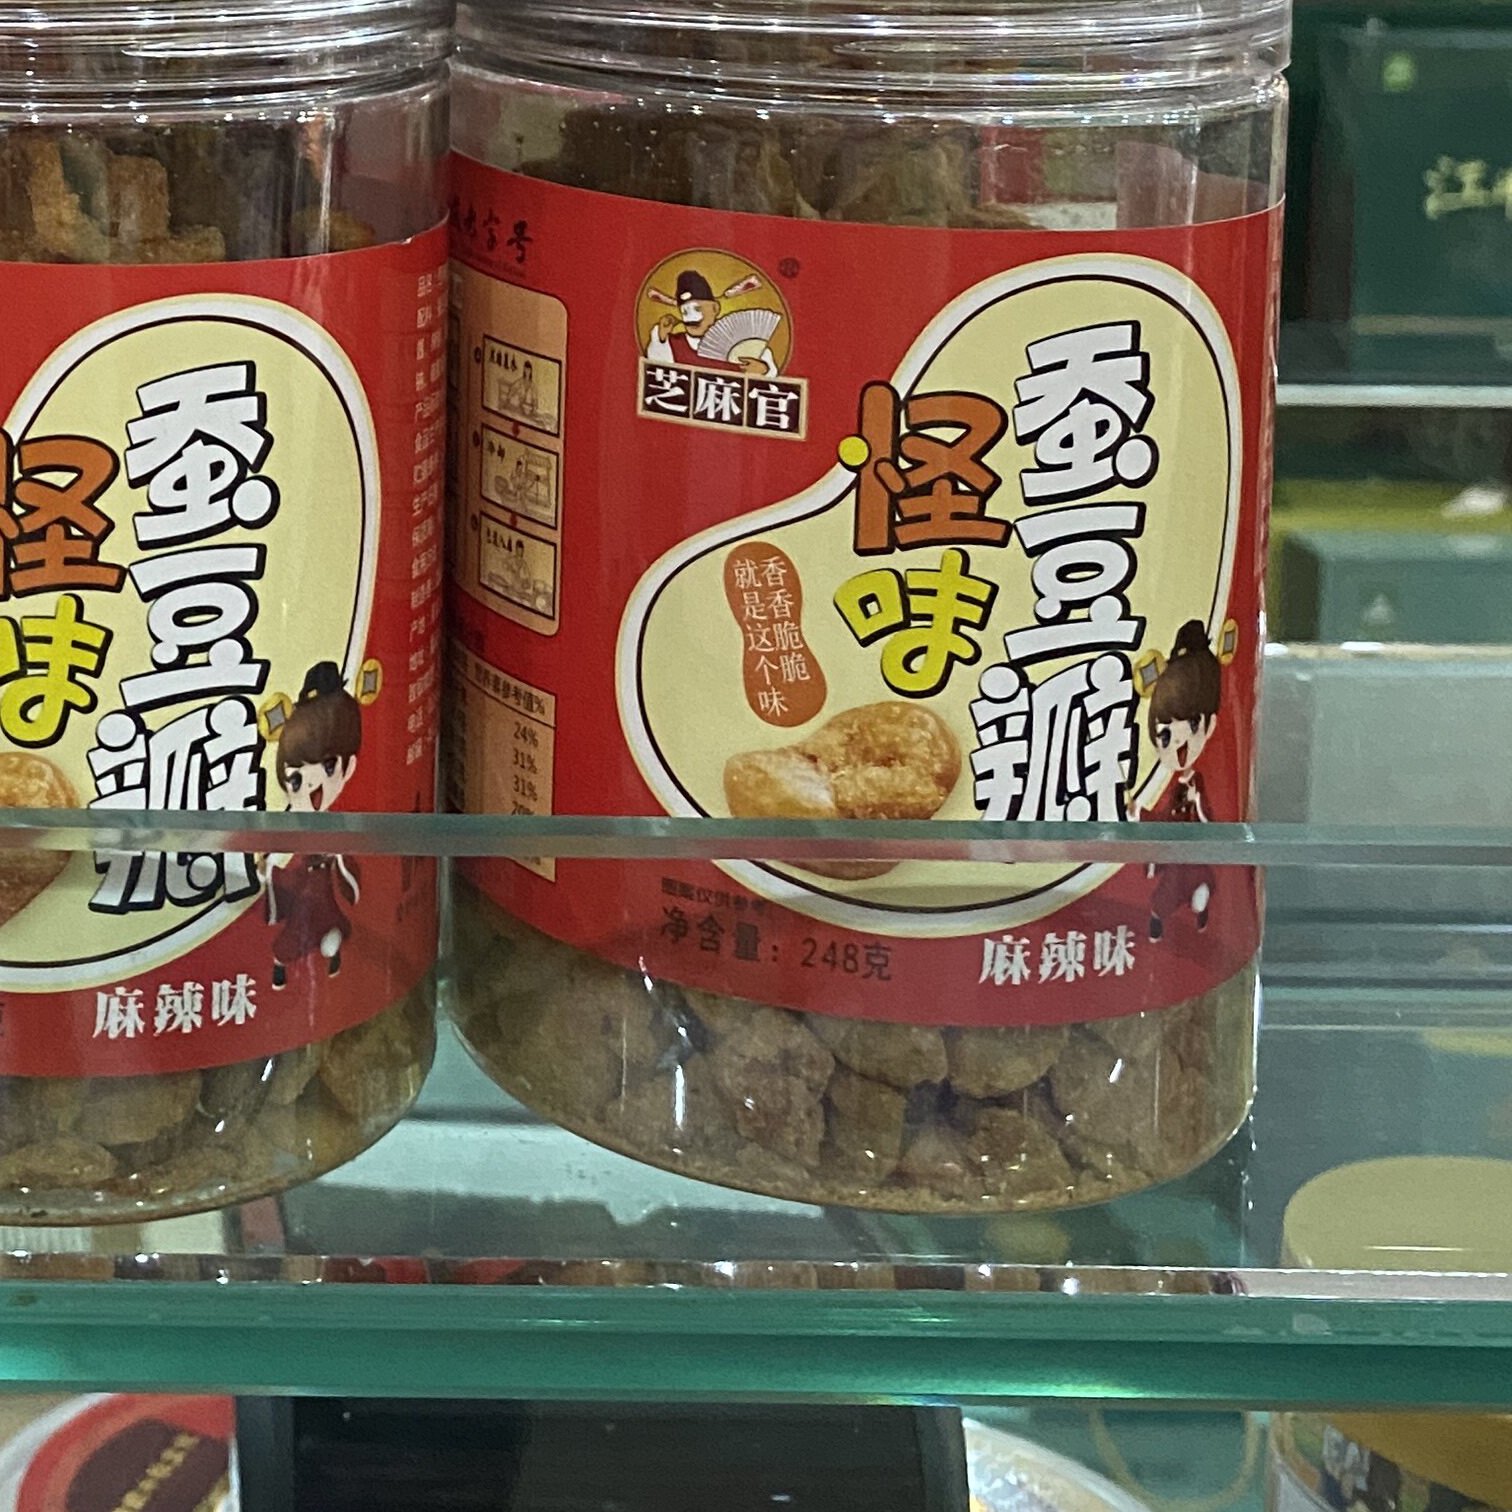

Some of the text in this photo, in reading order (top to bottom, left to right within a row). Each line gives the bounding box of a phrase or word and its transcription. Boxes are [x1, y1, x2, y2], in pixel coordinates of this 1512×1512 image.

[645, 368, 799, 429] 芝麻官
[733, 559, 789, 717] 就是这个味
[760, 556, 811, 683] 香香脆脆
[978, 925, 1136, 986] 麻辣味
[92, 974, 257, 1039] 麻辣味
